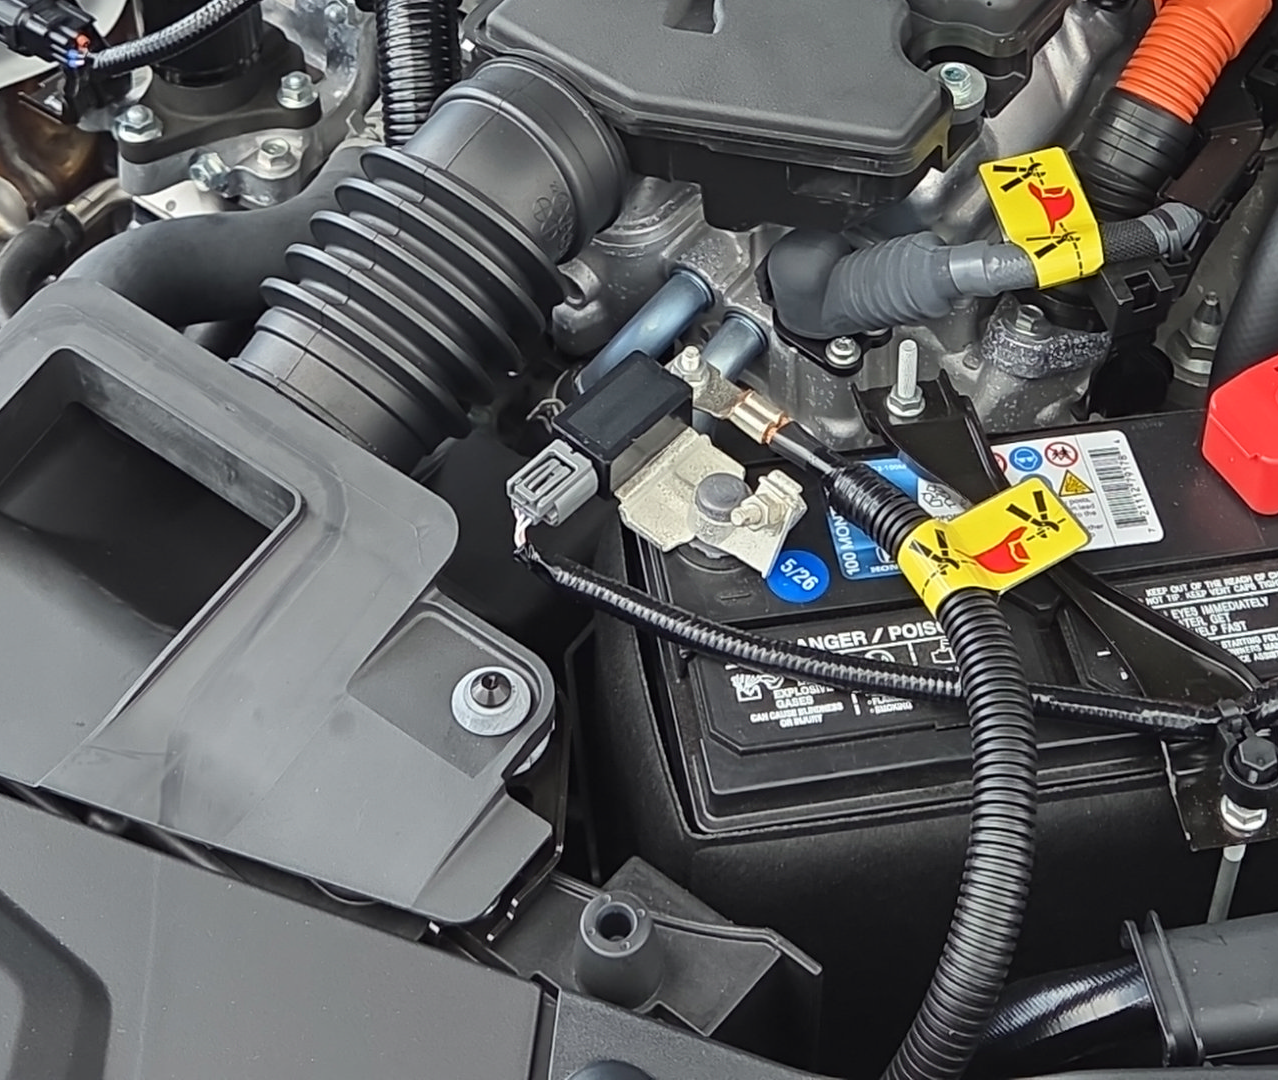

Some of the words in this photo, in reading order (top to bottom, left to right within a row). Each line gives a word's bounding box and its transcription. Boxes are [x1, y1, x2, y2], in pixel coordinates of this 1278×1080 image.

[829, 506, 855, 550] MON
[842, 552, 860, 576] 100
[869, 563, 899, 573] HON
[780, 557, 819, 591] 5/26
[1145, 587, 1168, 597] KEEP
[1170, 584, 1188, 594] OUT
[1190, 582, 1203, 591] OF
[1206, 580, 1222, 589] THE
[1223, 575, 1253, 587] REACH
[1254, 572, 1267, 581] OF
[1145, 595, 1163, 606] NOT
[1184, 589, 1208, 600] KEEP
[1209, 586, 1232, 597] VENT
[1234, 582, 1258, 593] CAPS
[1170, 606, 1199, 620] EYES
[1200, 596, 1269, 616] IMMEDIATELY
[1209, 612, 1231, 624] GET
[1221, 620, 1248, 634] FAST
[797, 630, 868, 651] ANGER
[871, 627, 884, 644] /
[888, 621, 945, 641] POIS
[1220, 635, 1262, 650] STARTING
[773, 683, 835, 699] EXPLOSIV
[776, 695, 814, 709] GASES
[875, 701, 914, 714] SMOKING
[749, 712, 770, 723] CAN
[770, 708, 798, 720] CAUSE
[798, 702, 844, 717] BLINDNESS
[779, 717, 793, 728] OR
[794, 714, 823, 726] INJURY
